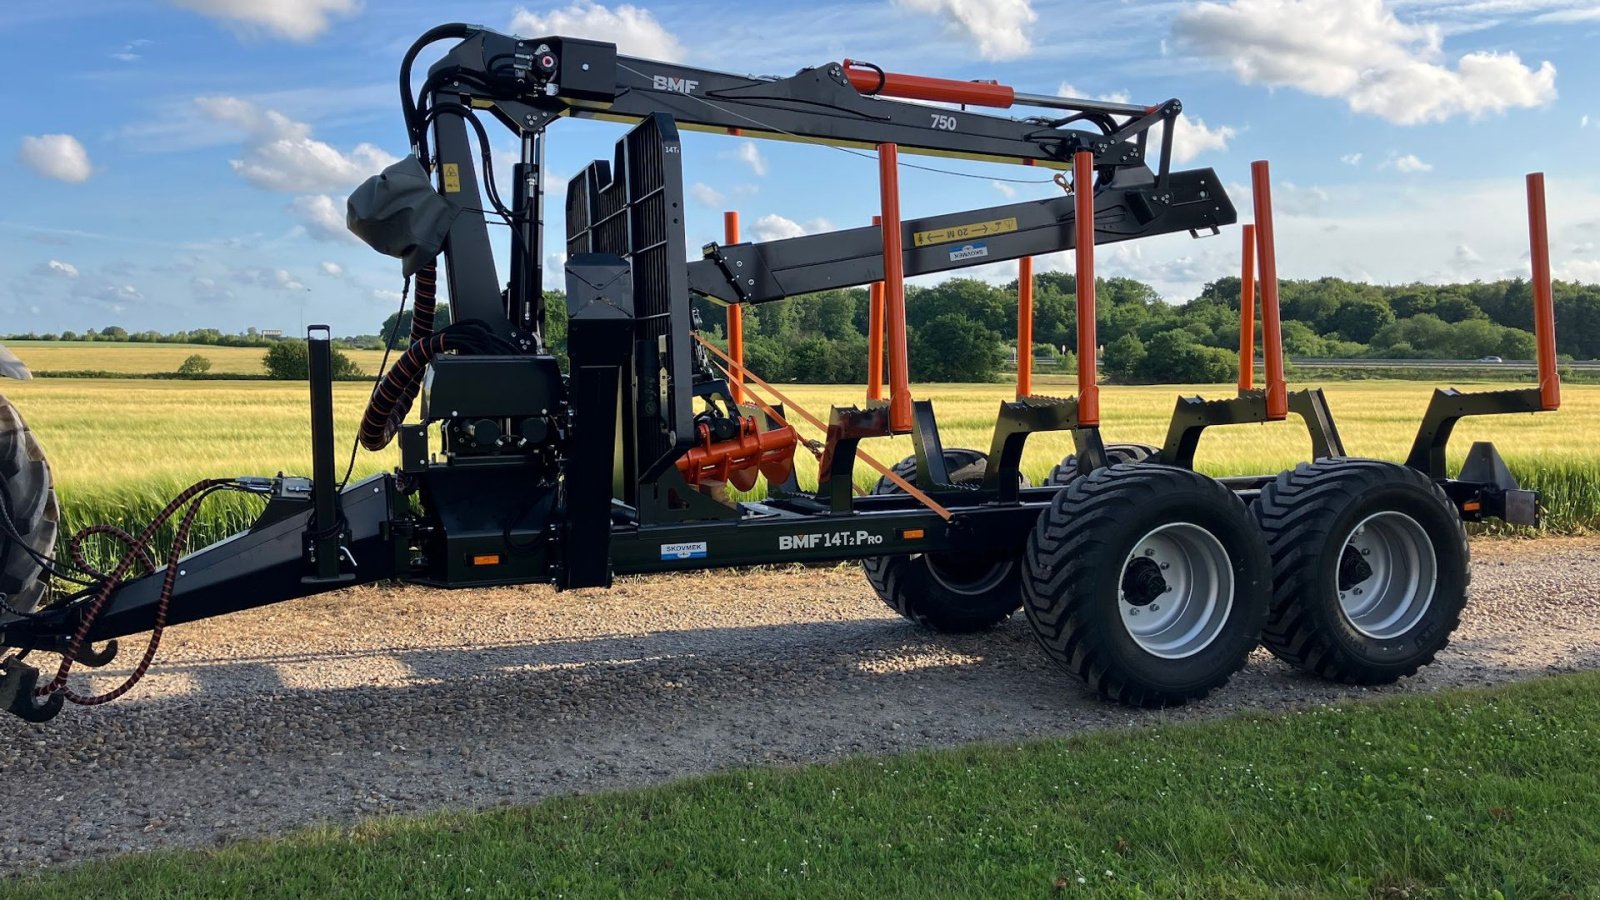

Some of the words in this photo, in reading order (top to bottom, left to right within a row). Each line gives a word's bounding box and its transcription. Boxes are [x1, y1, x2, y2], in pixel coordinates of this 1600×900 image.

[653, 75, 699, 94] BMF
[930, 114, 957, 131] 750
[946, 231, 955, 239] M
[957, 227, 969, 237] 20
[953, 249, 984, 259] SKOVMEK
[779, 533, 822, 550] BMF
[666, 544, 702, 552] SKOVMEK
